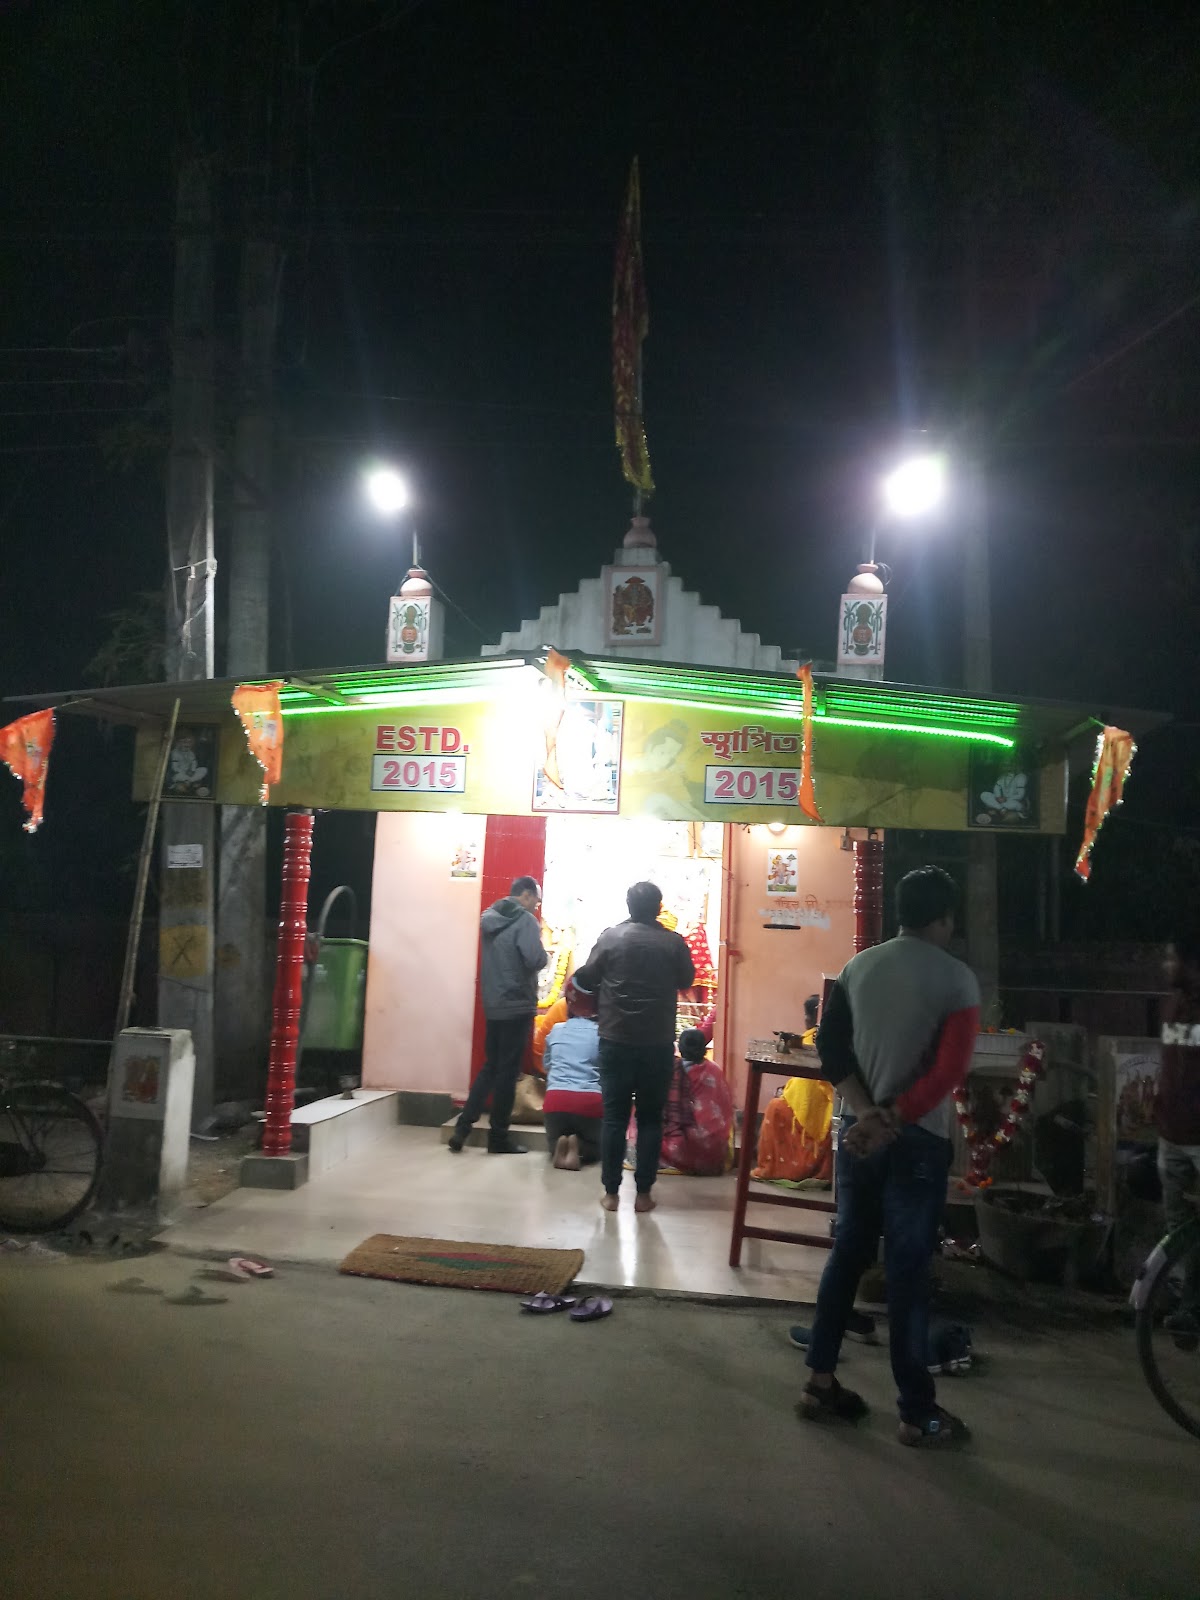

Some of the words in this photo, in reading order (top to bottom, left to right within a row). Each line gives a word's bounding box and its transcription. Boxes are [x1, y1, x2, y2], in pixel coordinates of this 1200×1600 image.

[376, 724, 470, 754] ESTD.
[700, 724, 800, 761] স্থাপিত
[382, 760, 457, 789] 2015
[714, 769, 798, 801] 2015
